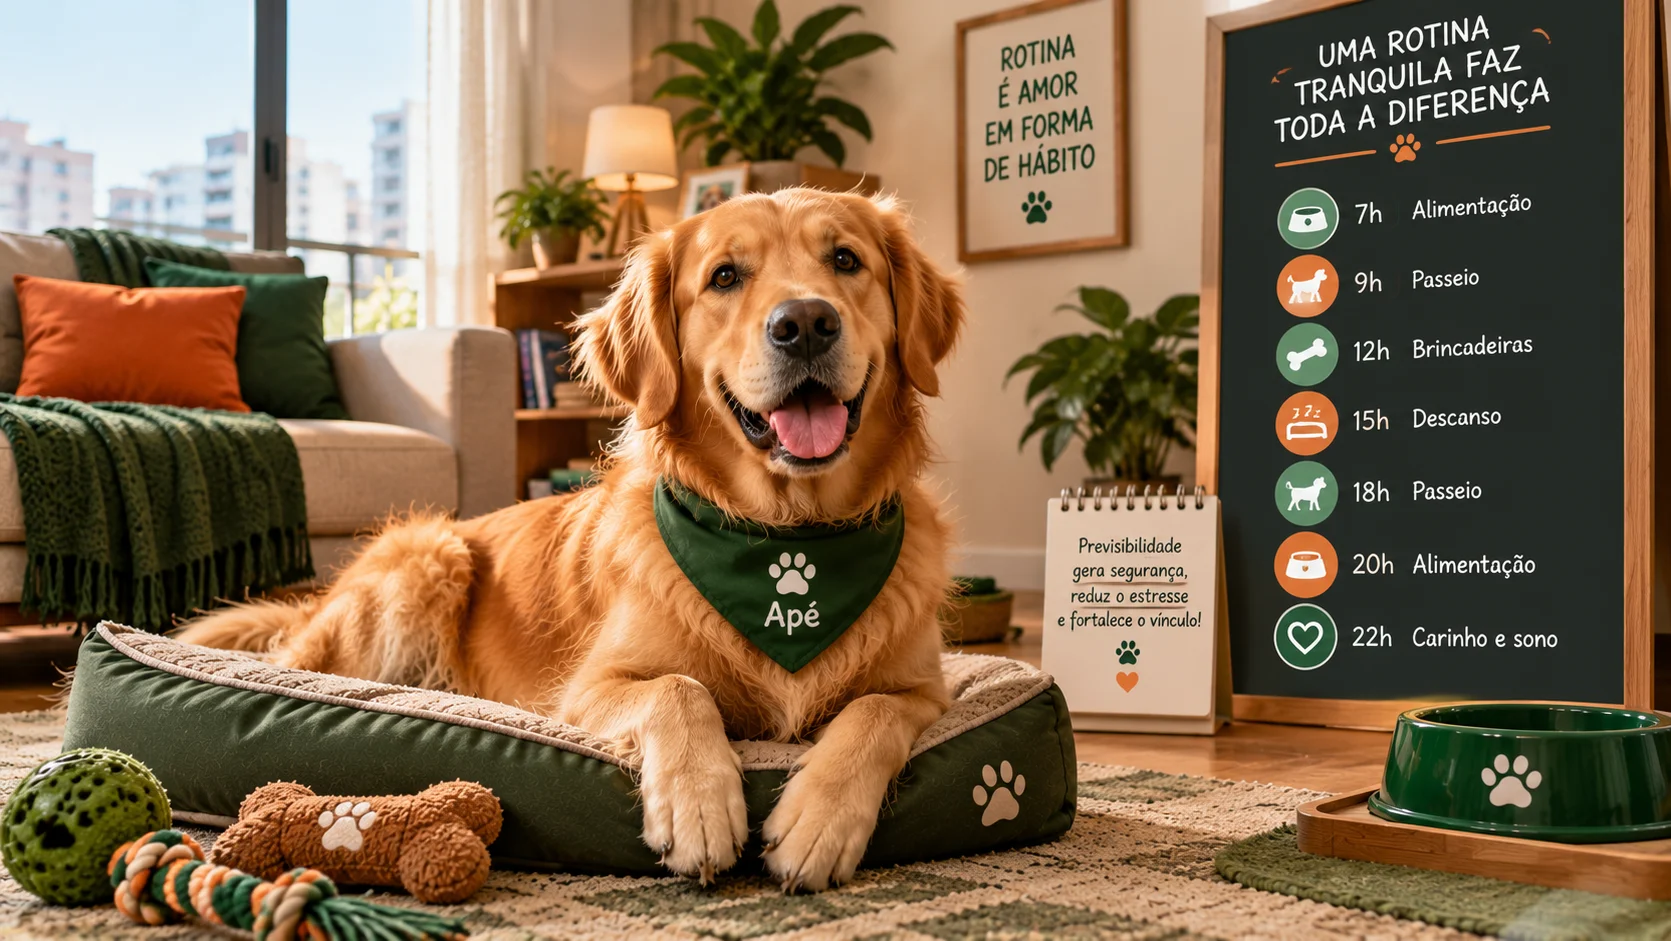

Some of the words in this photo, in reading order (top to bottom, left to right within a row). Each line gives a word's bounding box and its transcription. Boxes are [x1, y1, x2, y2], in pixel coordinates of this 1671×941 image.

[1002, 34, 1075, 71] ROTINA
[1320, 36, 1376, 67] UMA
[1388, 15, 1489, 56] ROTINA
[1294, 57, 1452, 105] TRANQUILA
[1467, 45, 1521, 77] FAZ
[999, 77, 1009, 108] É
[1018, 71, 1077, 104] AMOR
[1274, 110, 1345, 142] TODA
[1358, 105, 1375, 130] A
[1389, 77, 1549, 125] DIFERENÇA
[986, 119, 1012, 146] EM
[1022, 106, 1093, 141] FORMA
[985, 156, 1009, 182] DE
[1019, 144, 1095, 177] HÁBITO
[1355, 202, 1382, 224] 7h
[1413, 194, 1531, 219] Alimentação
[1355, 271, 1381, 293] 9h
[1413, 269, 1479, 289] Passeio
[1354, 340, 1389, 361] 12h
[1413, 335, 1532, 358] Brincadeiras
[1354, 409, 1388, 430] 15h
[1413, 409, 1501, 428] Descanso
[1354, 481, 1389, 502] 18h
[1413, 481, 1481, 500] Passeio
[1079, 537, 1181, 553] Previsibilidade
[1073, 567, 1104, 584] gera
[1110, 566, 1188, 582] segurança,
[1353, 553, 1393, 574] 20h
[1413, 553, 1535, 578] Alimentação
[1071, 587, 1110, 603] reduz
[1116, 593, 1124, 602] o
[1130, 589, 1188, 603] estresse
[764, 601, 819, 635] Apé
[1058, 617, 1065, 626] e
[1070, 611, 1132, 631] fortalece
[1138, 617, 1145, 627] o
[1150, 611, 1201, 627] vínculo!
[1353, 626, 1391, 646] 22h
[1413, 626, 1487, 647] Carinho
[1495, 634, 1505, 647] e
[1514, 634, 1557, 647] sono
